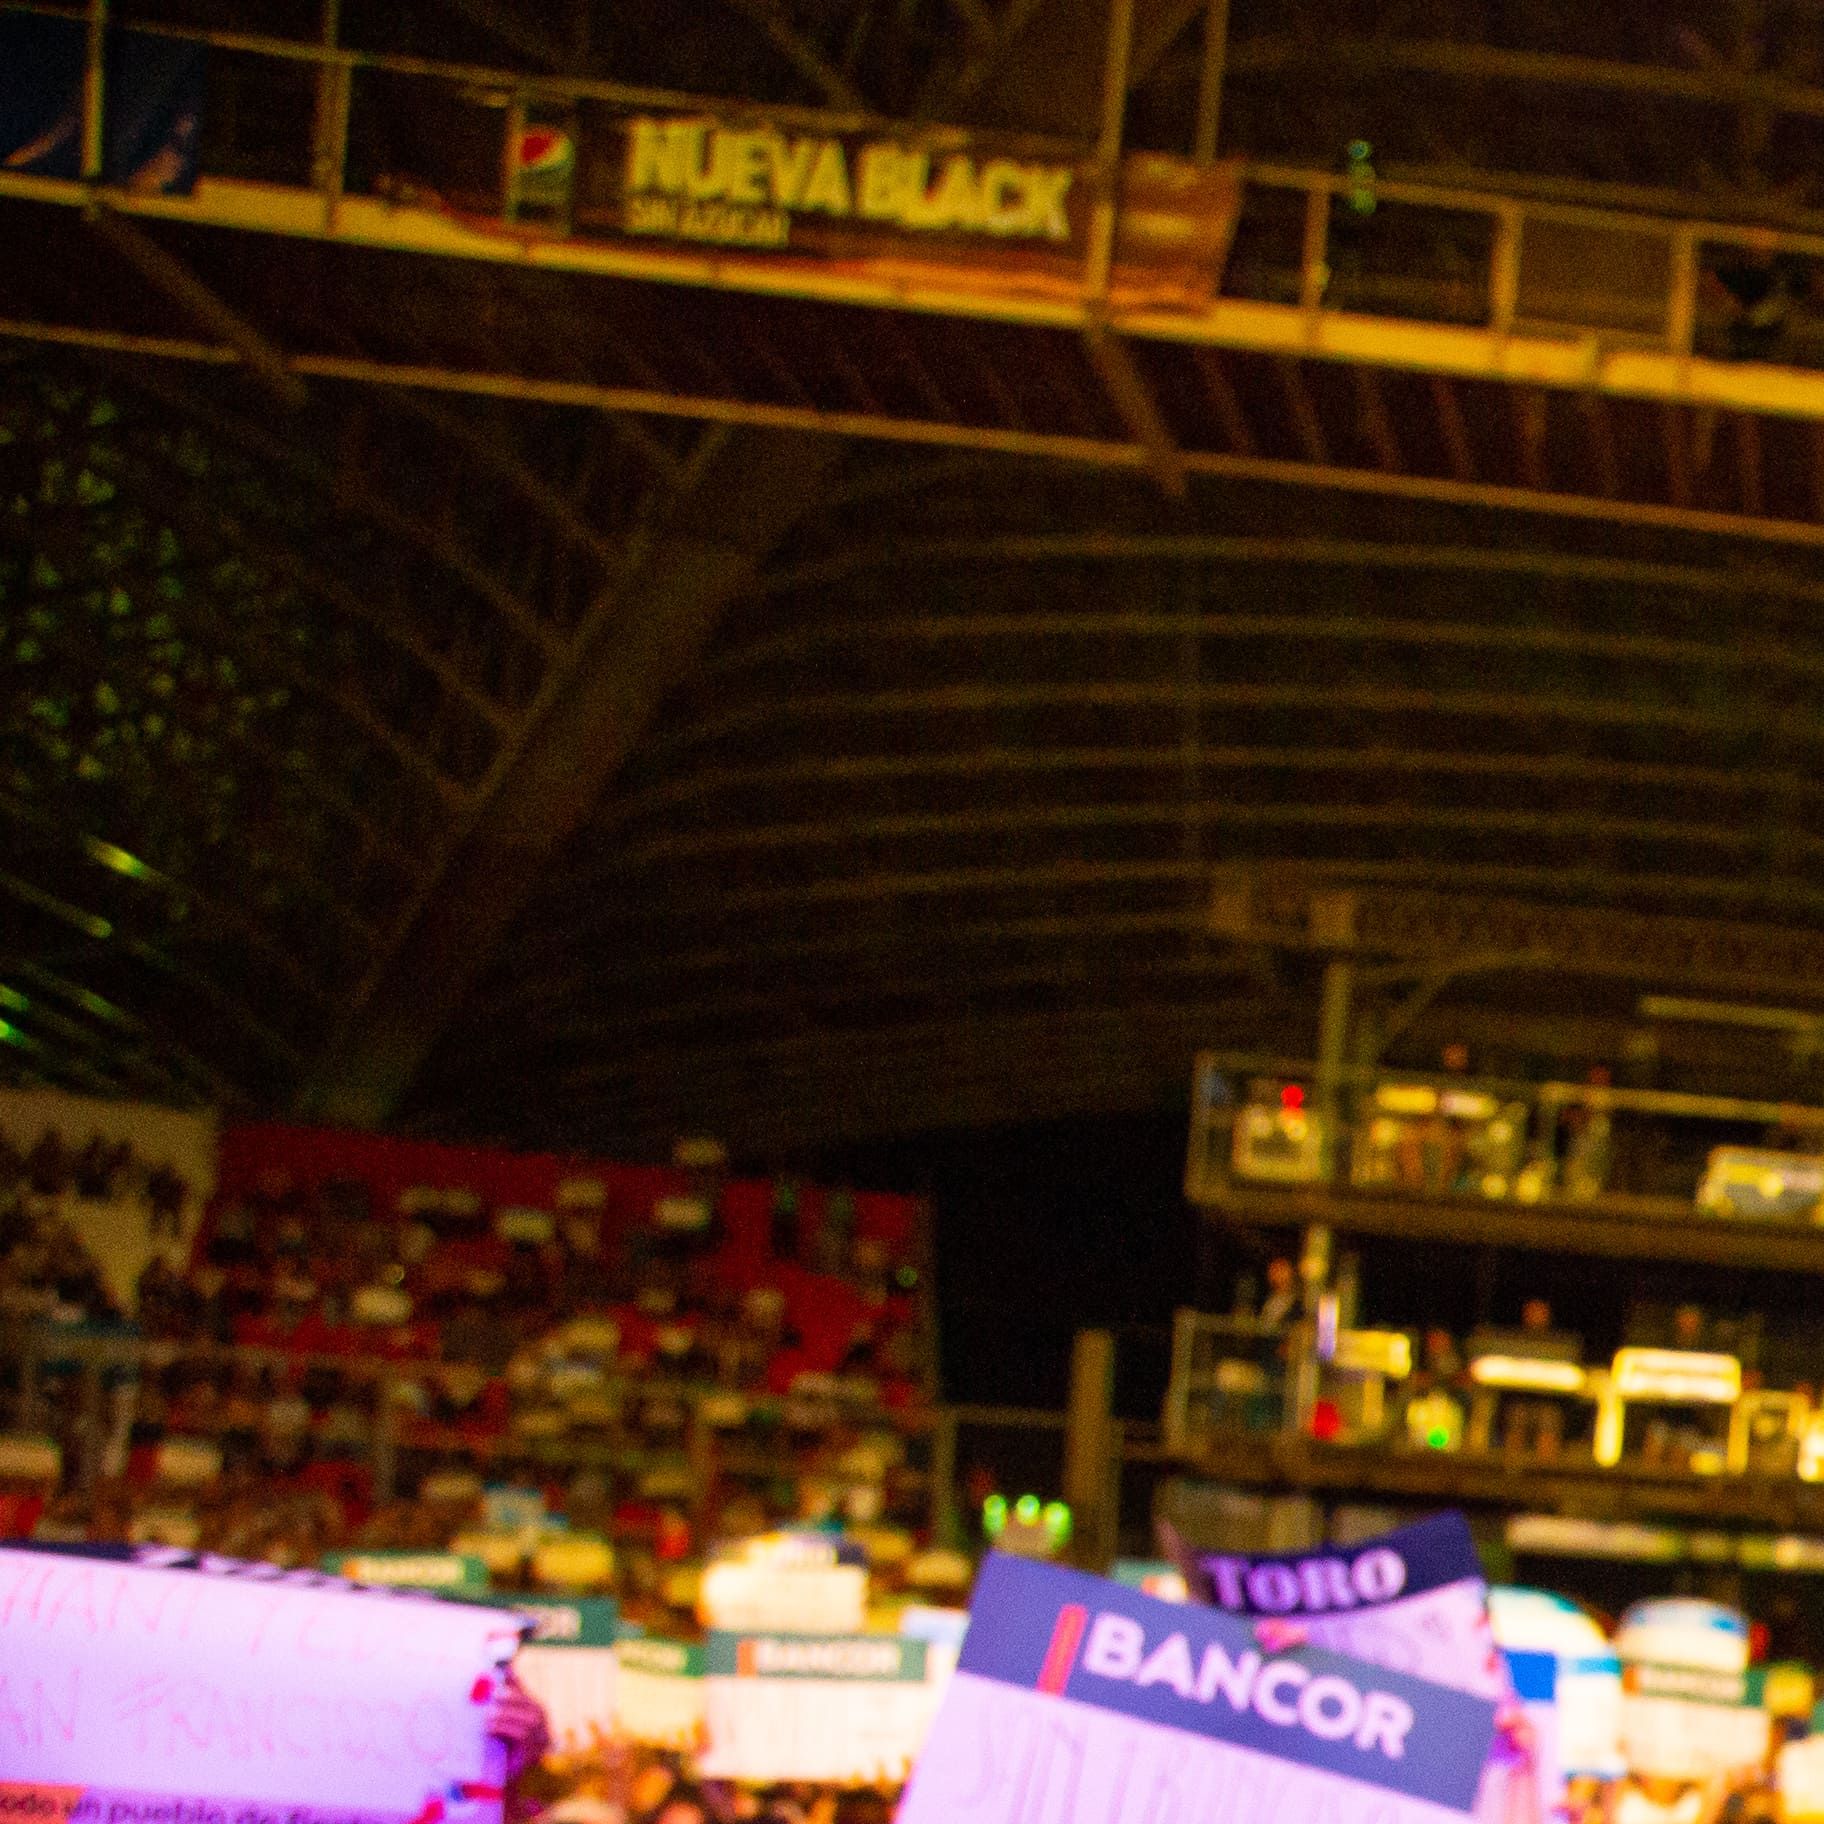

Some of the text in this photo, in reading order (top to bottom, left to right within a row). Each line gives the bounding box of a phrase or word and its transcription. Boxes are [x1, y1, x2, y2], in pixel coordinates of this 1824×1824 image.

[628, 119, 1072, 241] NUEVA BLACK
[1201, 1547, 1407, 1611] TORO
[1083, 1610, 1416, 1760] BANCOR
